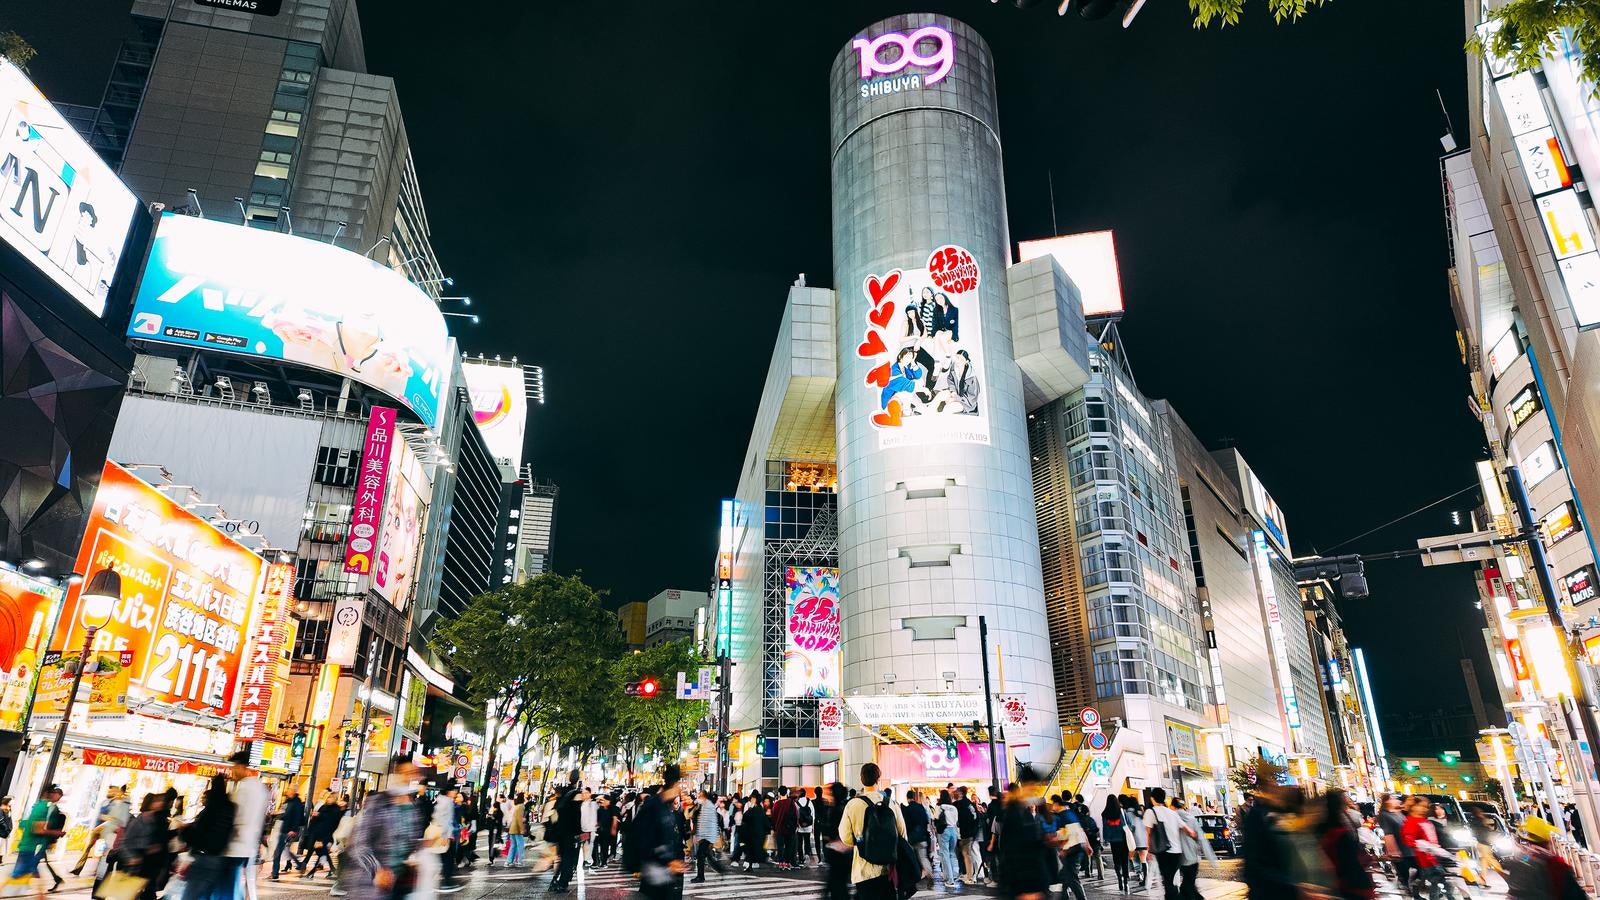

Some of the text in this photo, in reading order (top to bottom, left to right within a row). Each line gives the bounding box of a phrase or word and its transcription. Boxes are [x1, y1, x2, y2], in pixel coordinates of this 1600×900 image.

[852, 26, 955, 86] 109
[860, 75, 920, 98] SHIBUYA
[929, 247, 972, 273] 45th
[931, 264, 978, 287] SHIBUYA109
[943, 277, 977, 294] LOVE
[357, 427, 388, 522] 品川美容外科
[1266, 596, 1281, 623] LABI
[794, 634, 838, 651] LOVE
[918, 699, 978, 710] SHIBUYA109
[936, 710, 978, 718] CAMPAIGN
[1084, 712, 1096, 722] 30
